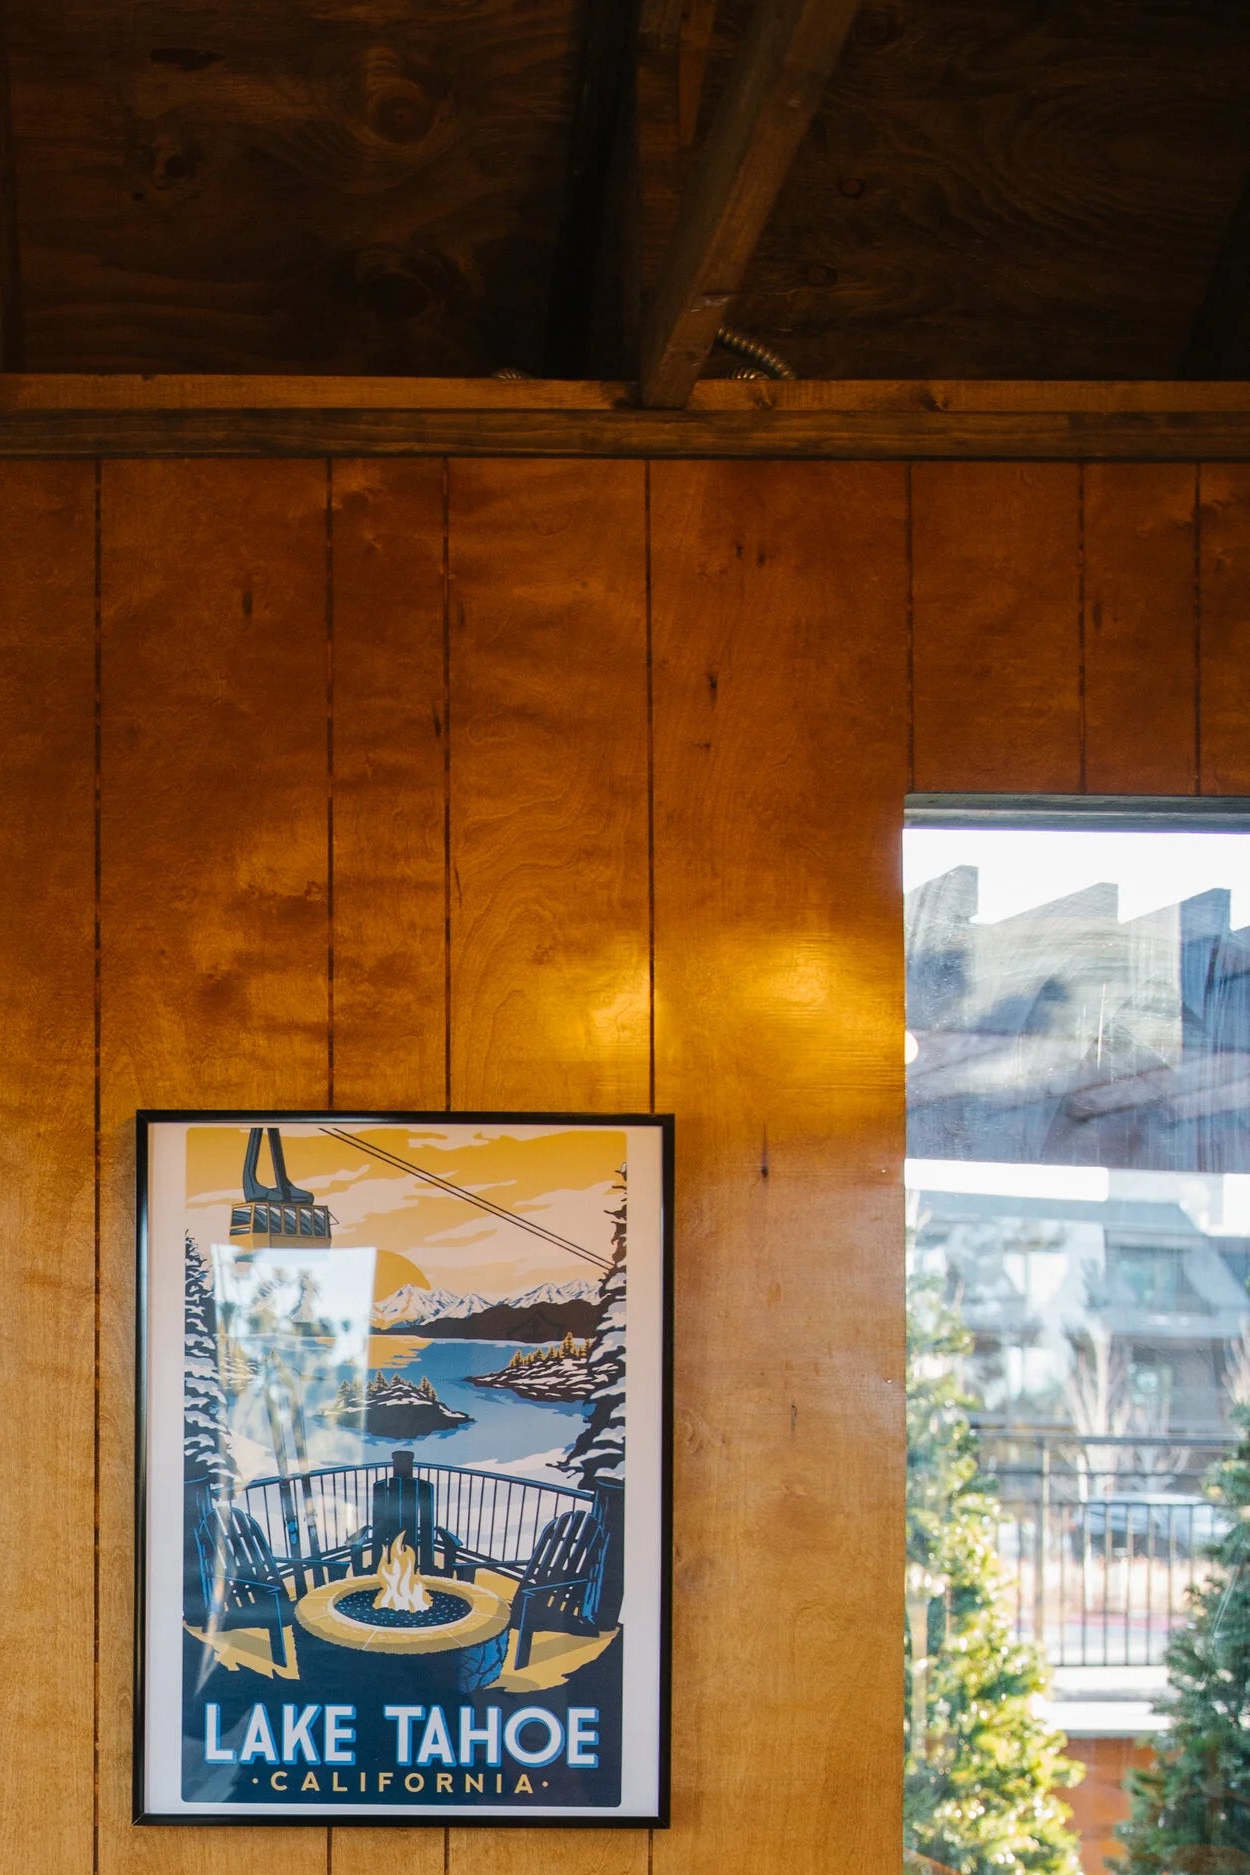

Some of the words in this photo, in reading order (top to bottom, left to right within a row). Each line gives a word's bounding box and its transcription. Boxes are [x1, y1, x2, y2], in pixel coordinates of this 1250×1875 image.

[204, 1702, 356, 1766] LAKE
[383, 1704, 599, 1768] TAHOE
[270, 1771, 533, 1794] CALIFORNIA
